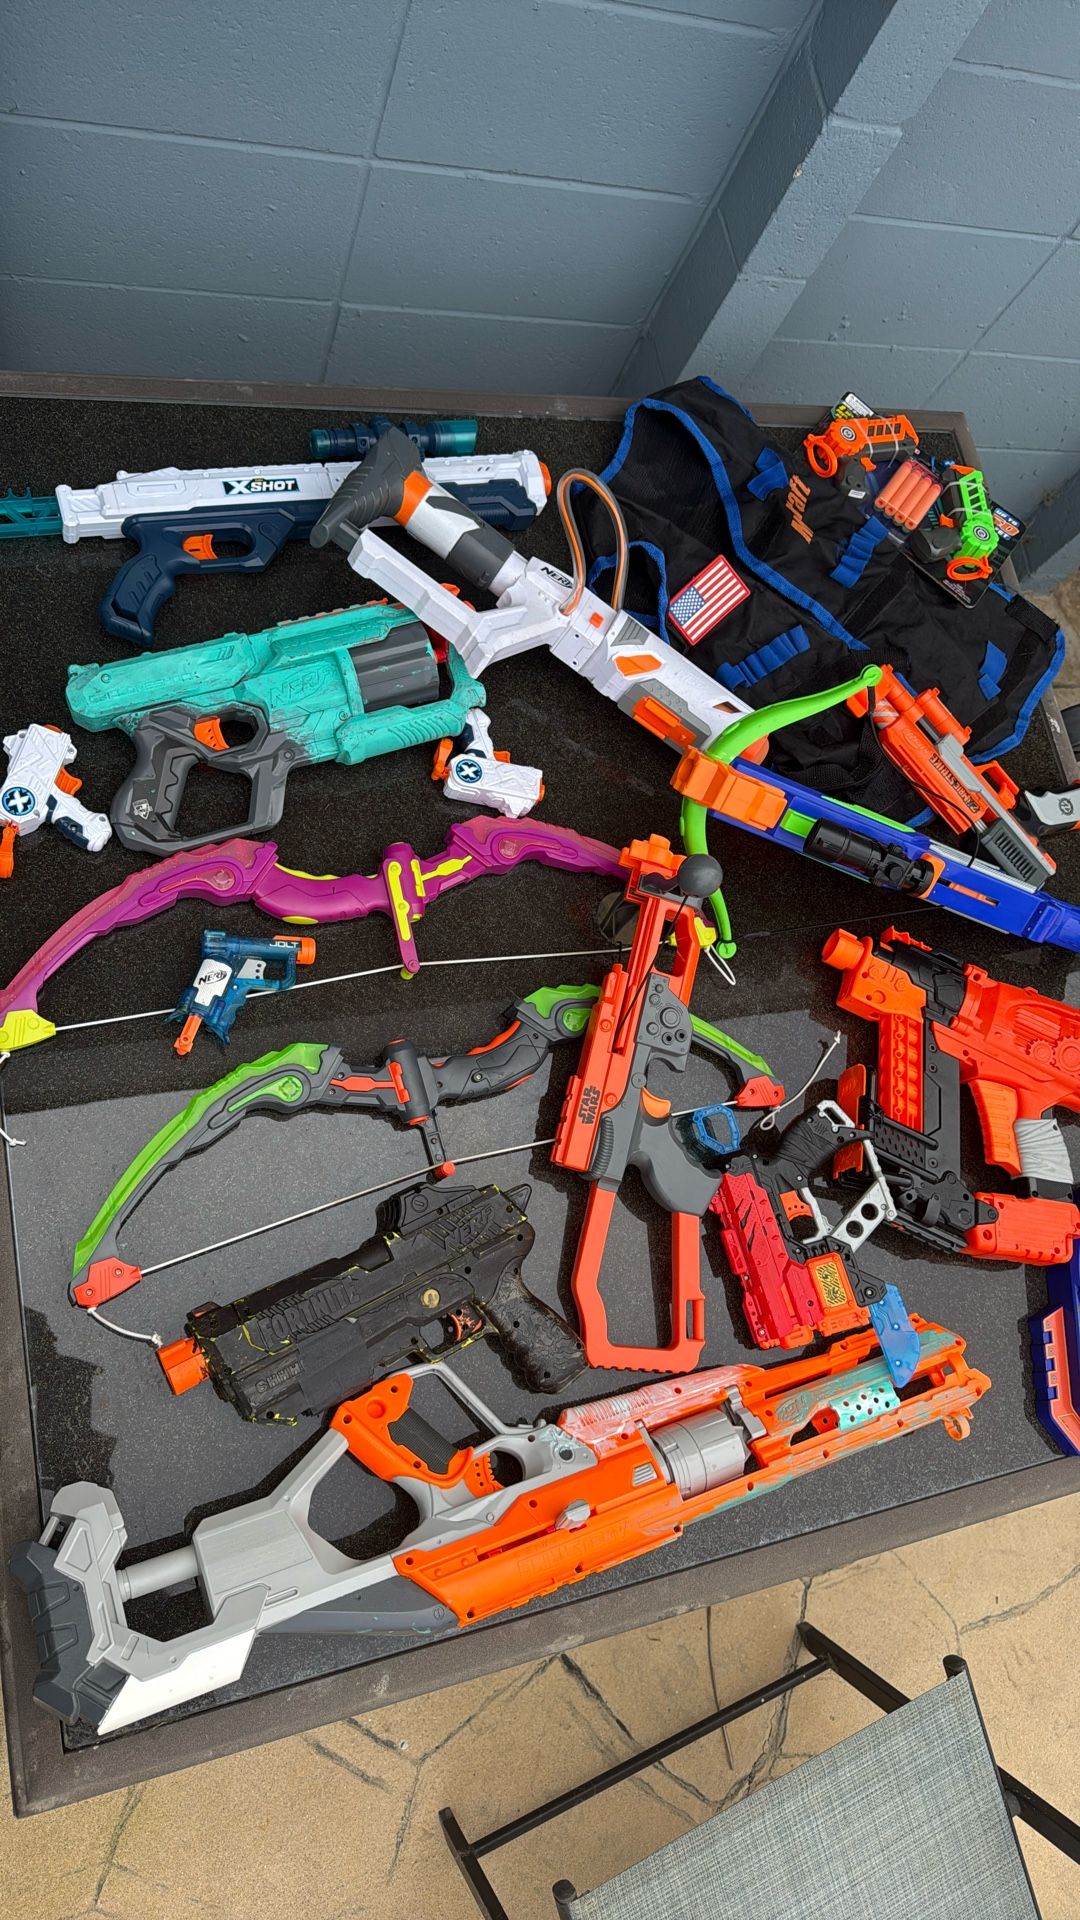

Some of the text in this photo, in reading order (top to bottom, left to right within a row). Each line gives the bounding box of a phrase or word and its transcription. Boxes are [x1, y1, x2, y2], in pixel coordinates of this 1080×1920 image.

[269, 941, 299, 949] JOLT
[198, 969, 227, 985] NERF
[578, 1086, 593, 1124] STAR
[584, 1087, 600, 1124] WARS
[257, 1278, 361, 1349] FORTNITE
